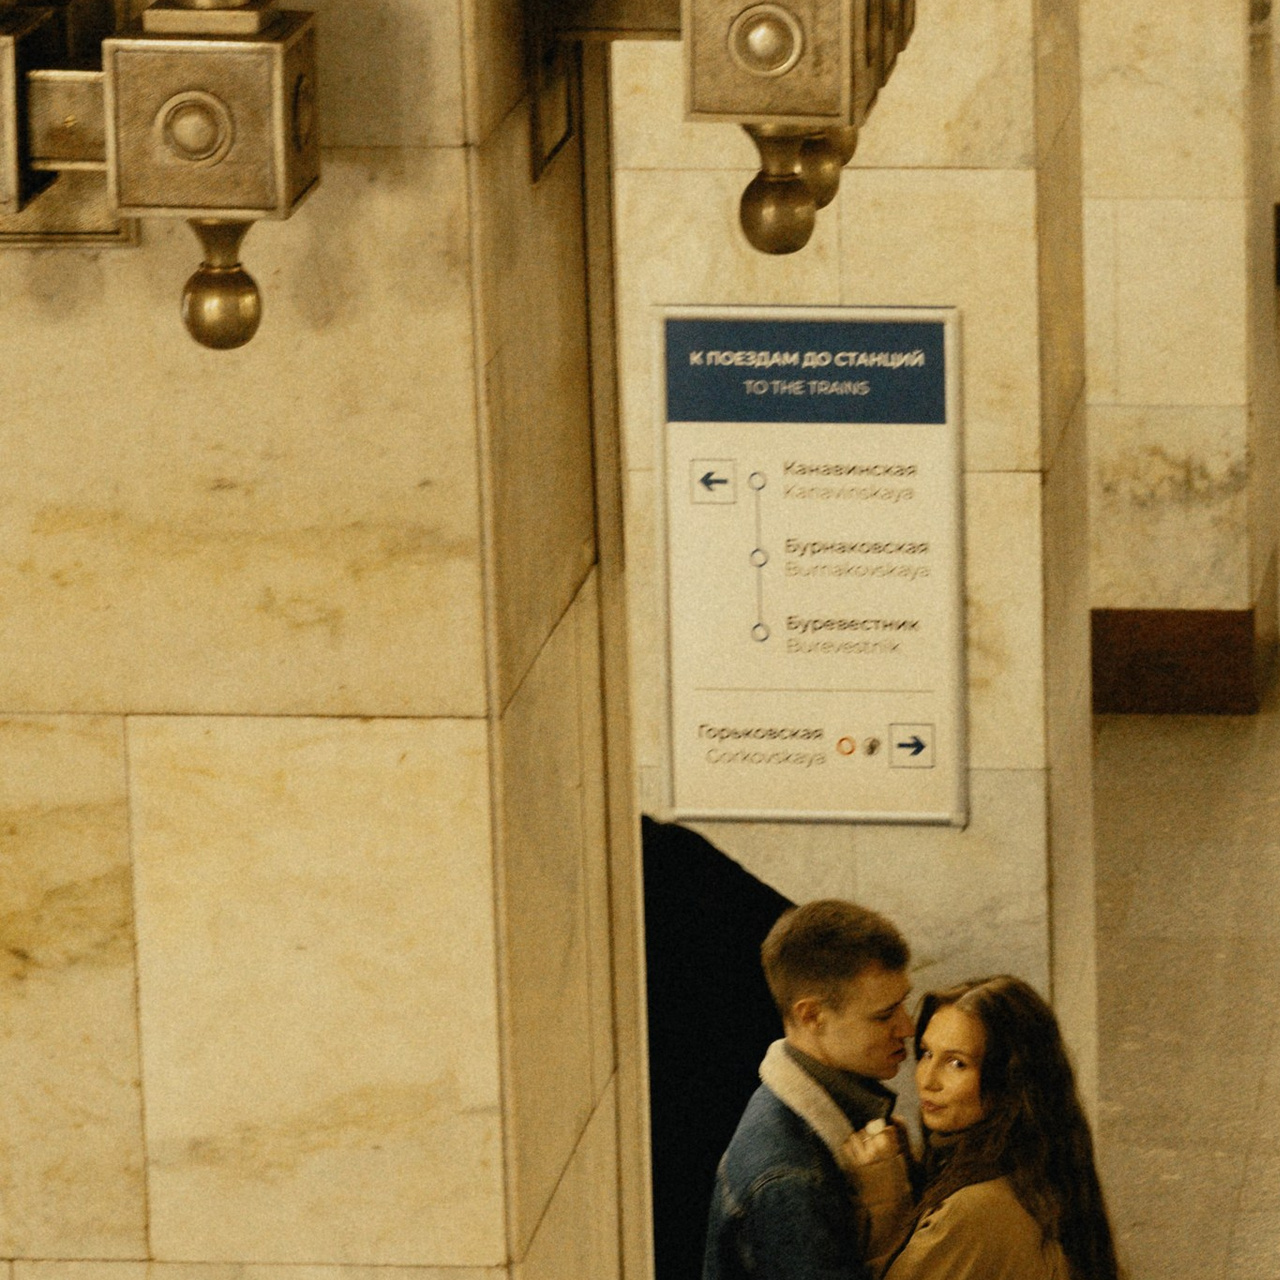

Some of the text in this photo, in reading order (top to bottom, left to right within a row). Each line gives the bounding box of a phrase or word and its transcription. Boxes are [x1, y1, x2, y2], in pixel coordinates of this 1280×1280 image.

[689, 349, 925, 369] К ПОЕЗДАМ ДО СТАНЦИЙ
[743, 379, 871, 396] TO THE TRAINS
[783, 460, 917, 476] Канавинская
[785, 538, 930, 557] Бурнаковская
[786, 615, 920, 634] Буревестник
[698, 724, 824, 743] Горьковская
